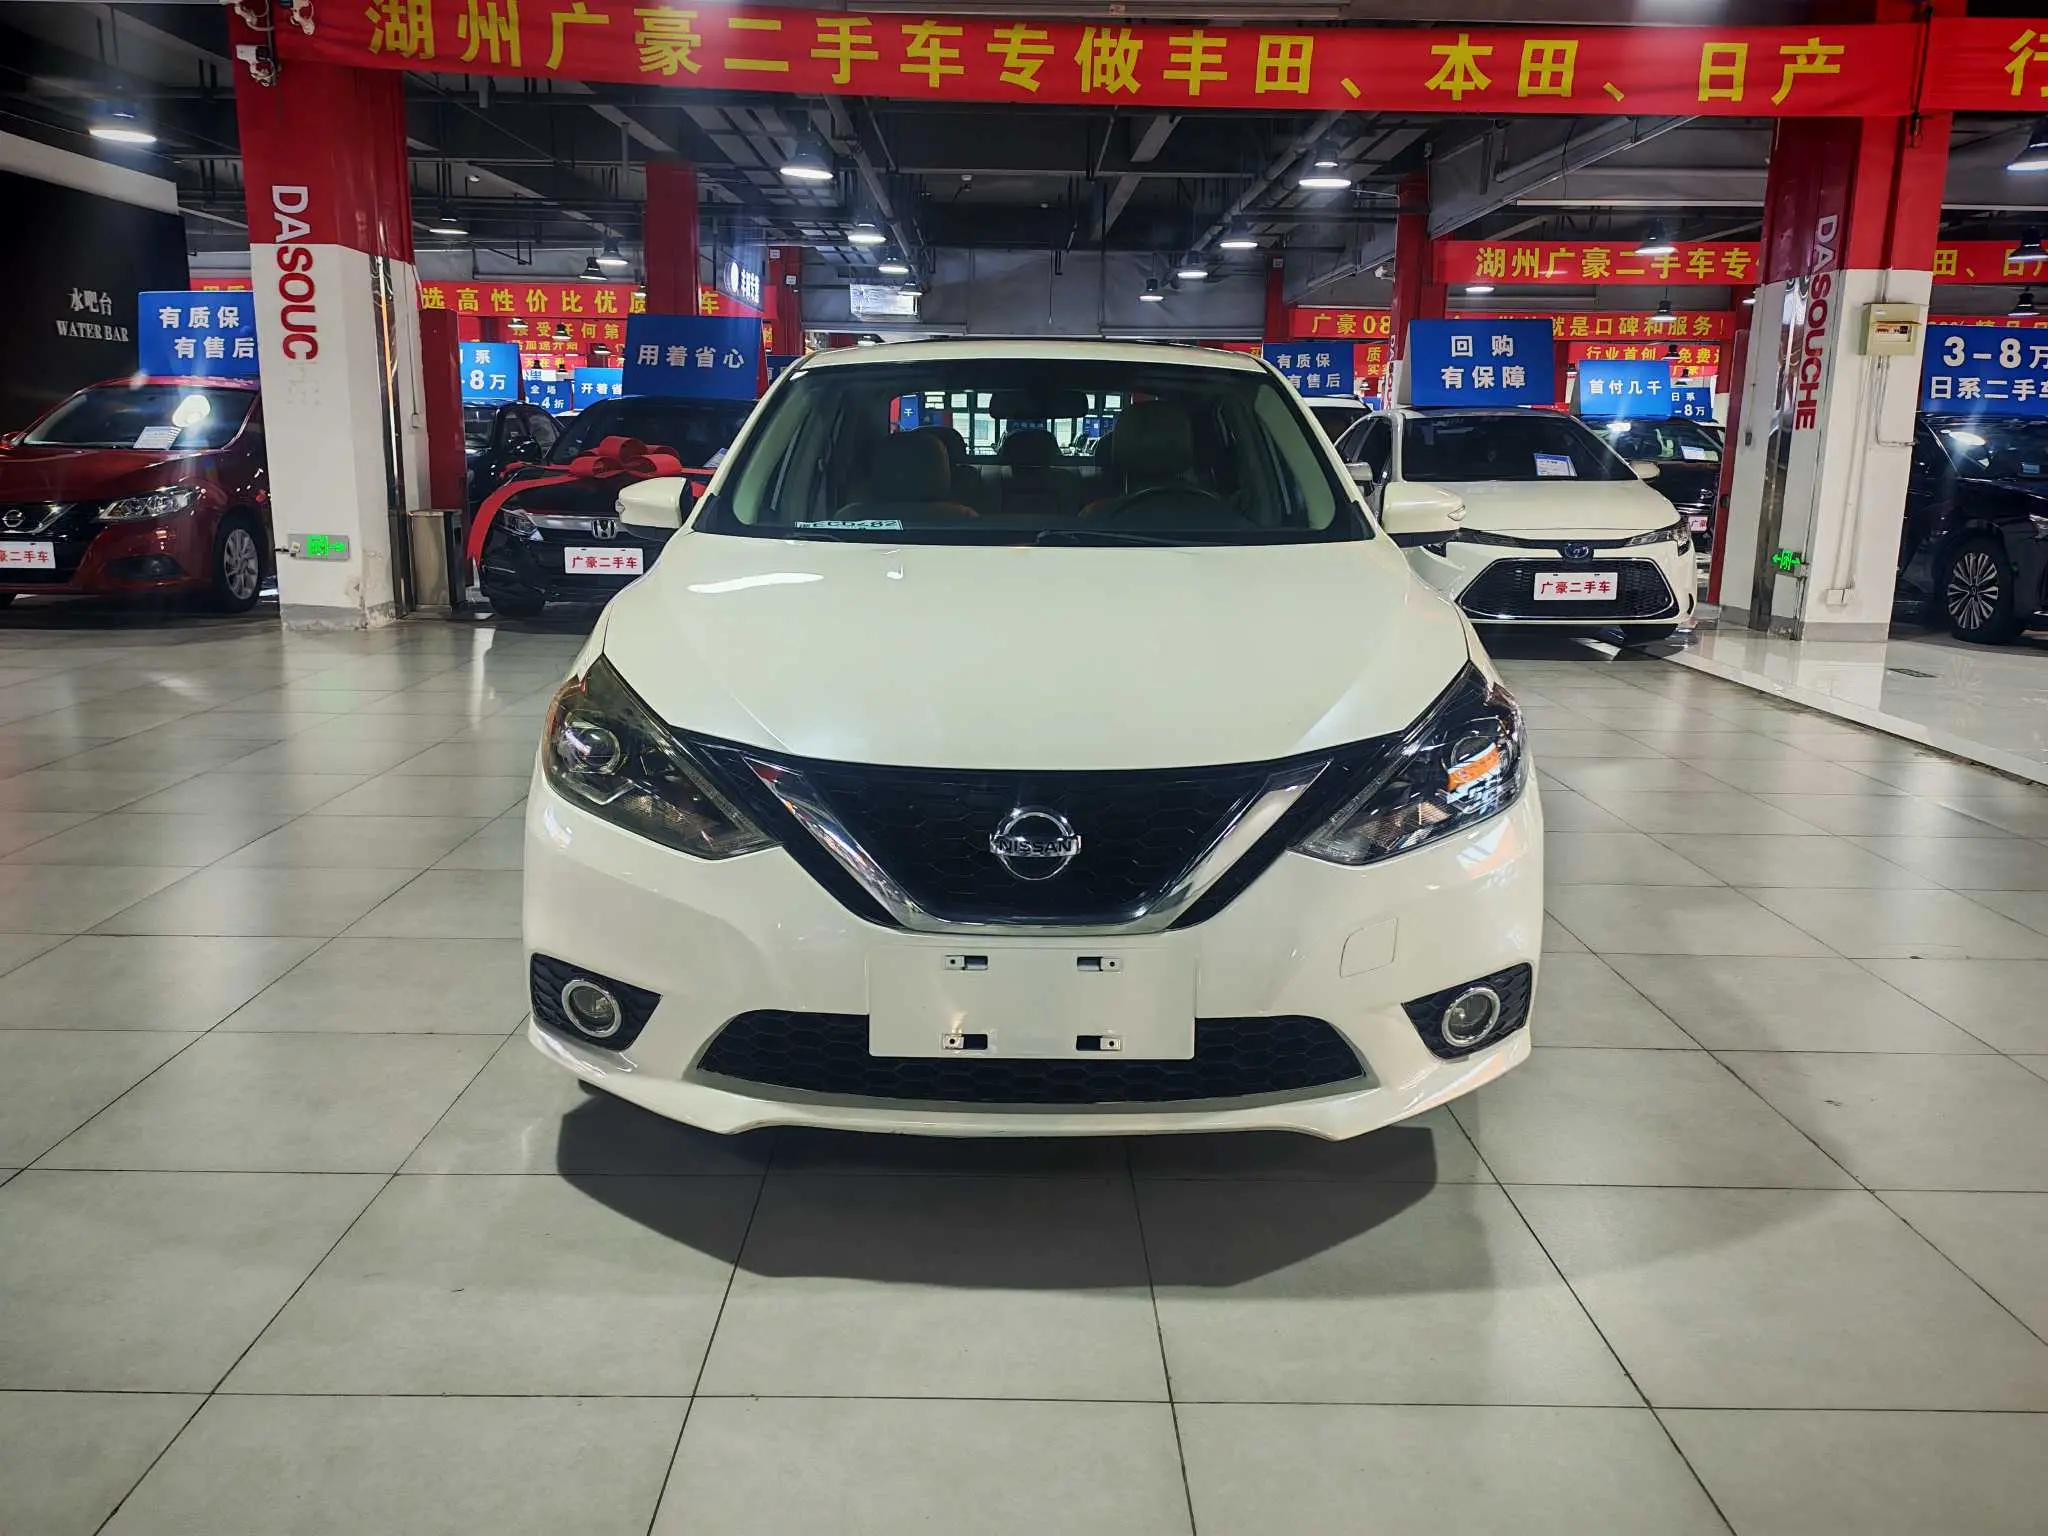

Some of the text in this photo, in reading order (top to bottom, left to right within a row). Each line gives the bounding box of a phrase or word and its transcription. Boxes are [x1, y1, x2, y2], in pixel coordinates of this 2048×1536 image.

[272, 185, 318, 360] DASOUC
[1475, 247, 2048, 279] 湖州广豪二手车专 田、日
[67, 287, 113, 316] 水吧台
[423, 287, 647, 313] 选高性价比优质
[159, 306, 240, 329] 有质保
[1795, 214, 1838, 430] DASOUCHE
[56, 320, 129, 342] WATER BAR
[174, 336, 255, 359] 有售后
[638, 344, 745, 369] 用着省心
[1451, 335, 1513, 357] 回购
[1943, 336, 2048, 369] 3-8万
[1277, 353, 1331, 369] 有质保
[1287, 373, 1341, 389] 有售后
[1441, 366, 1526, 389] 有保障
[1588, 378, 1662, 396] 首付几千
[572, 556, 637, 569] 广豪二手车
[1540, 581, 1610, 594] 广豪二手车
[999, 839, 1073, 853] NISSAN
